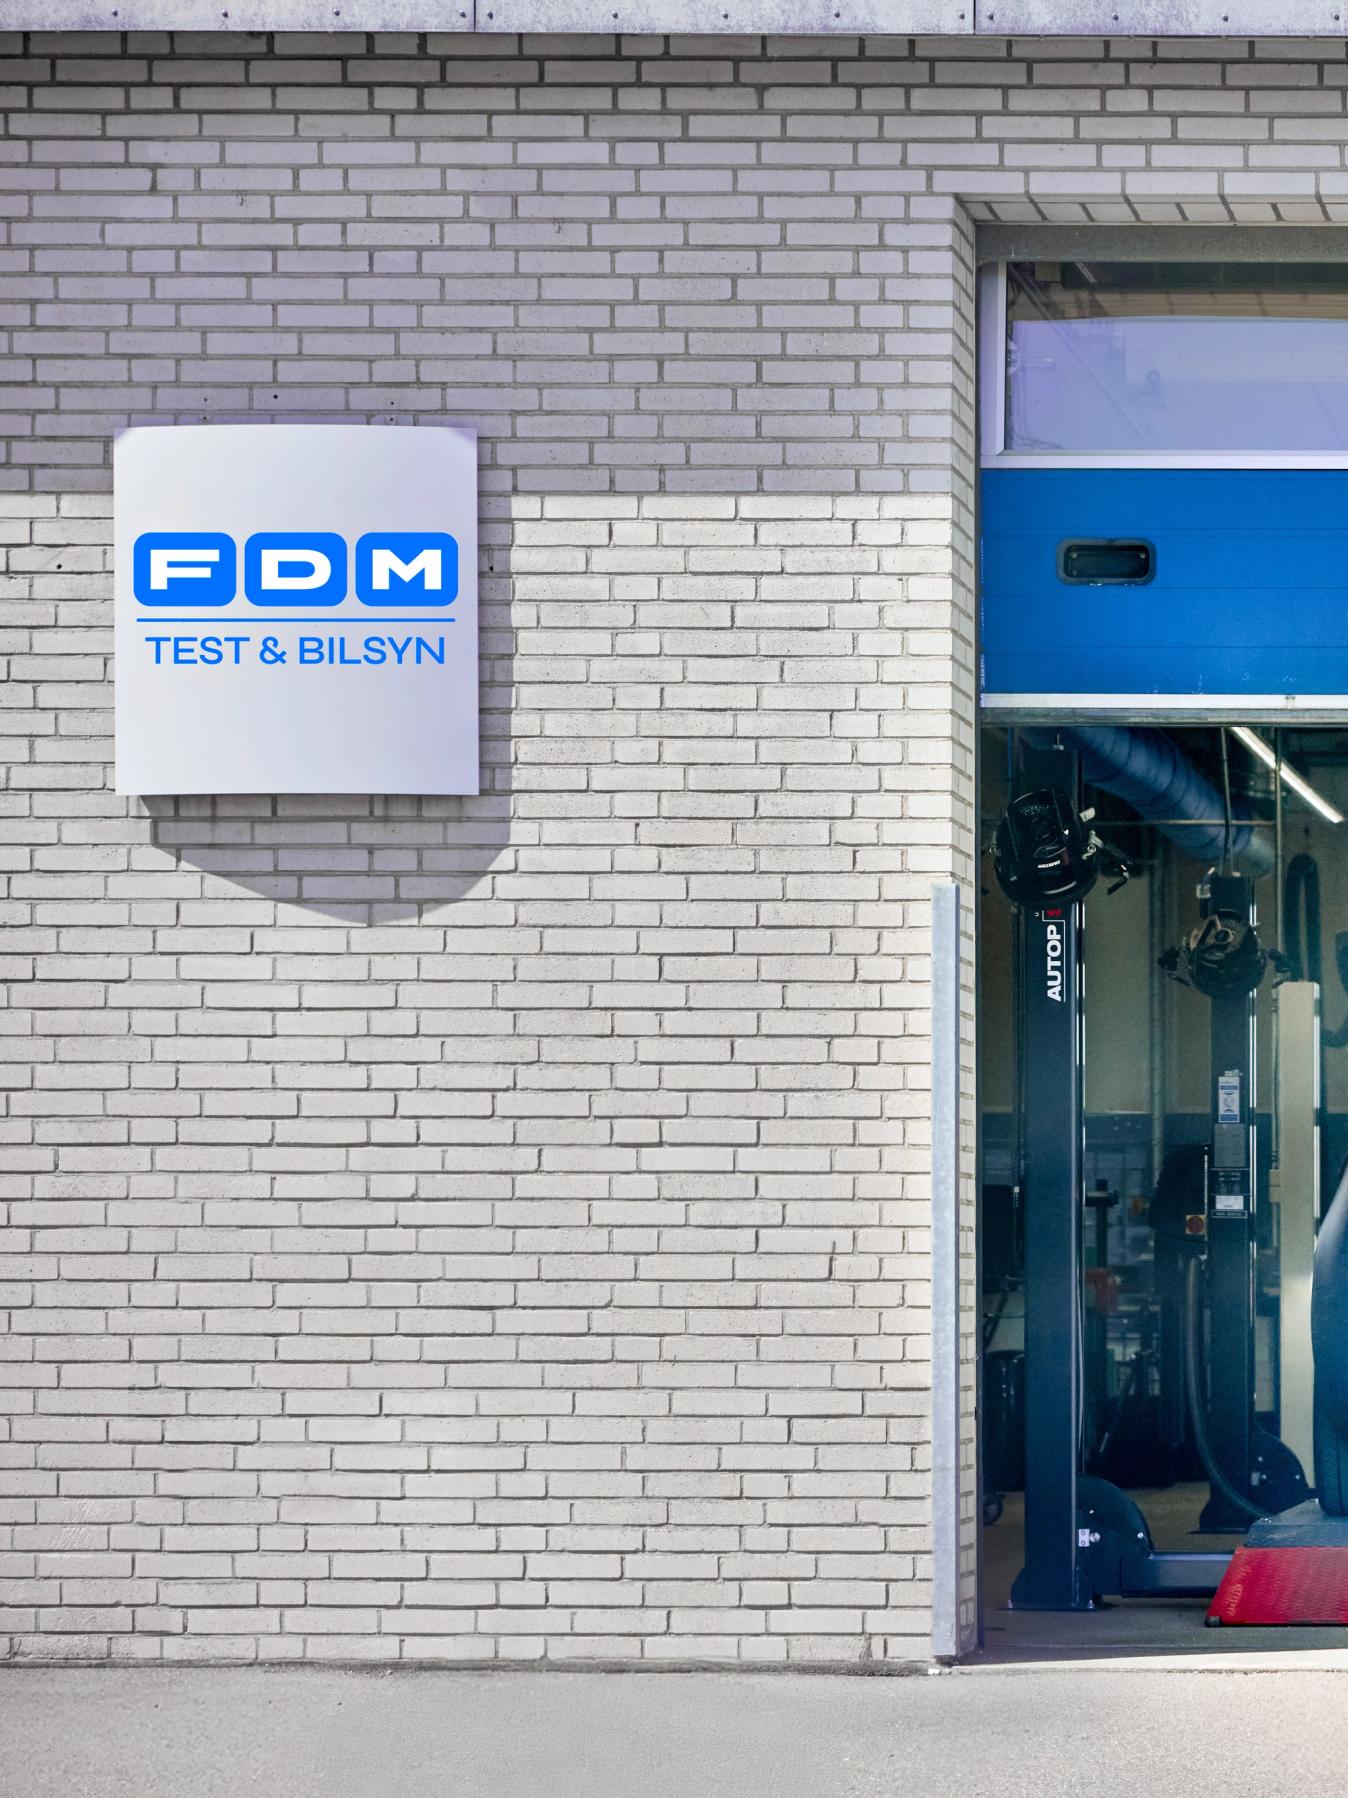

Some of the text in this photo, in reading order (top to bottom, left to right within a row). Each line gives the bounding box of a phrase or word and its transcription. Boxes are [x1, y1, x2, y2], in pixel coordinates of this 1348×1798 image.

[148, 547, 443, 592] FDM
[145, 636, 445, 664] TEST & BILSYN
[1047, 924, 1062, 1002] AUTOP
